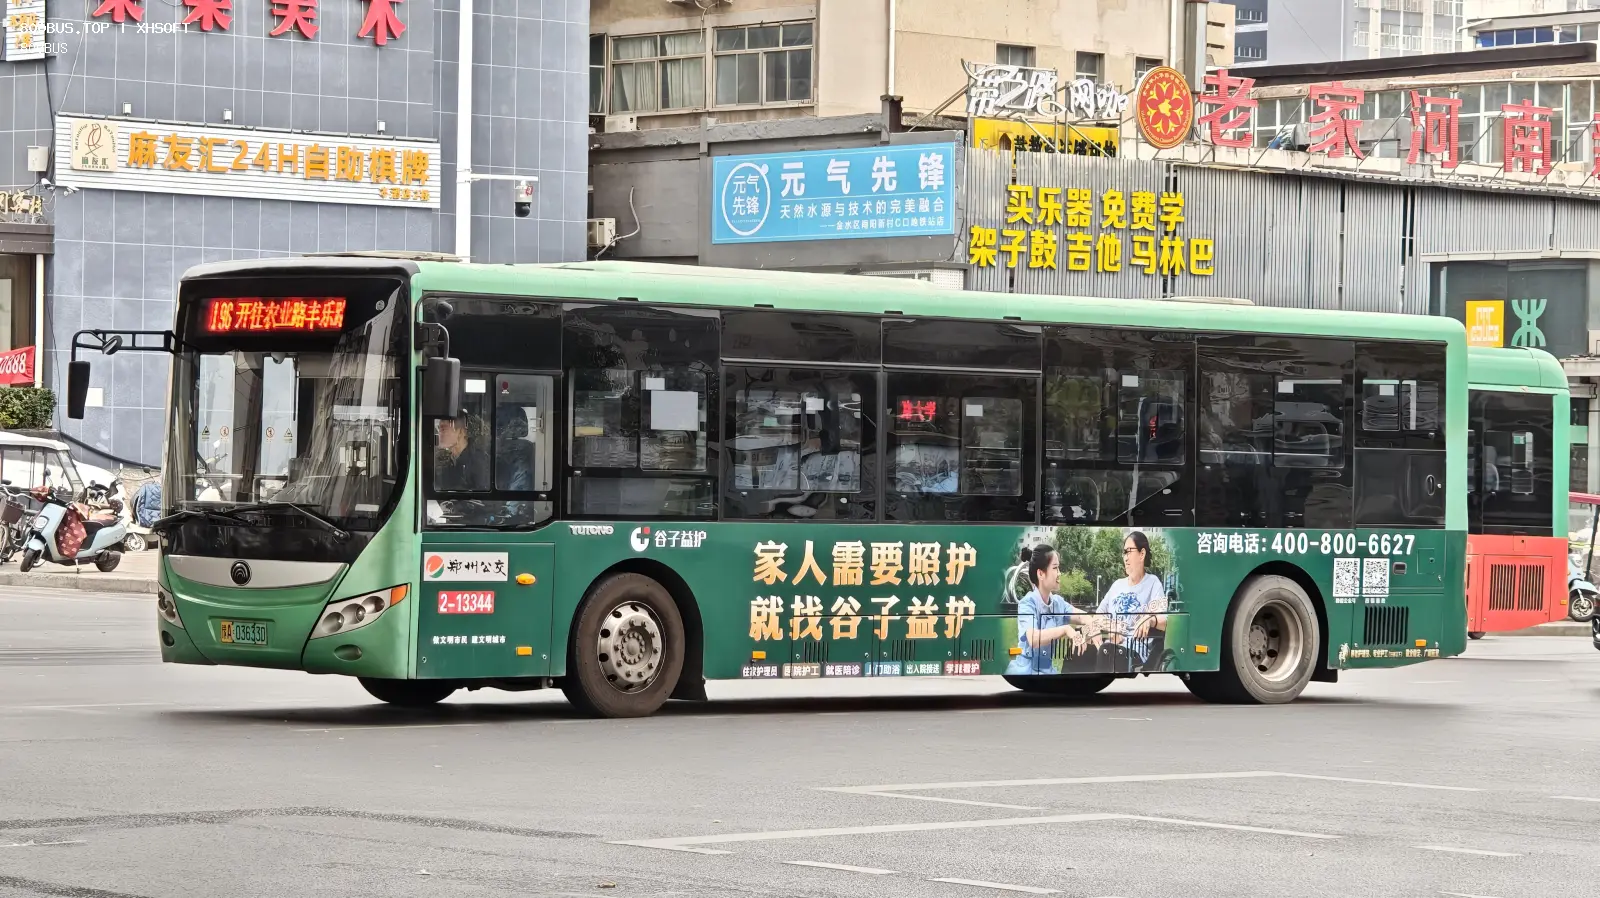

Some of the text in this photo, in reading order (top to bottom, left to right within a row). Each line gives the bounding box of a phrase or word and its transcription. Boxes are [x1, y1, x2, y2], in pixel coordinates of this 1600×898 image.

[1198, 69, 1600, 181] 老家河南
[127, 131, 431, 186] 麻友汇24H自助棋牌
[780, 153, 945, 198] 元气先锋
[780, 197, 945, 219] 天然水源与技术的完美融合
[569, 525, 614, 535] YUTONG
[654, 530, 707, 548] 谷子益护
[447, 560, 507, 577] 郑州公交
[753, 540, 978, 586] 家人需要照护
[438, 593, 493, 612] 2-13344
[749, 595, 976, 641] 就找谷子益护
[784, 664, 819, 677] 医院护工
[825, 664, 861, 676] 就医陪诊
[906, 663, 940, 674] 出入院接送
